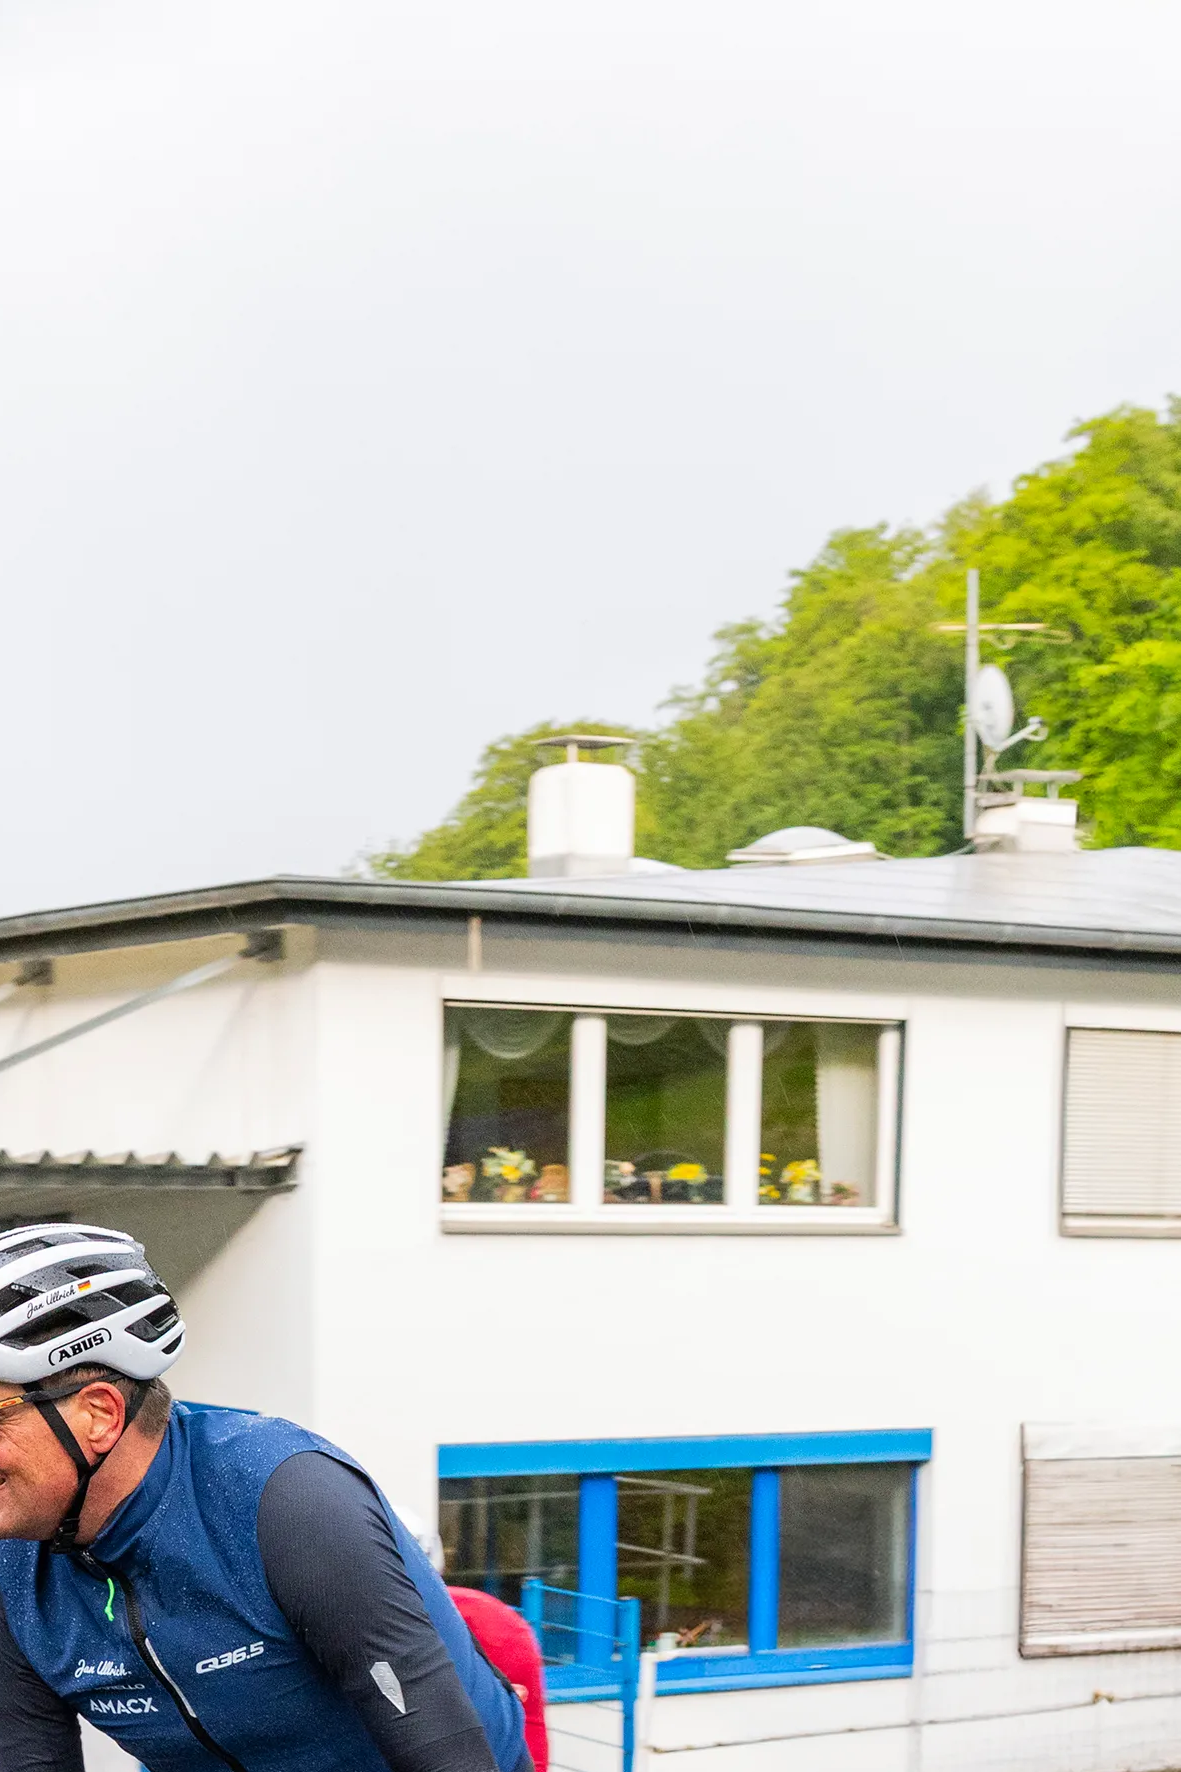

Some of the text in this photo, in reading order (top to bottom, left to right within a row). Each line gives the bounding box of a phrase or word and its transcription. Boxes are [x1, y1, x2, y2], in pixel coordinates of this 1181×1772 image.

[26, 1284, 77, 1319] Jan Ullrich
[58, 1329, 105, 1363] ABUS
[74, 1659, 96, 1679] Jan
[195, 1640, 265, 1675] Q36.5
[89, 1697, 159, 1715] AMACX
